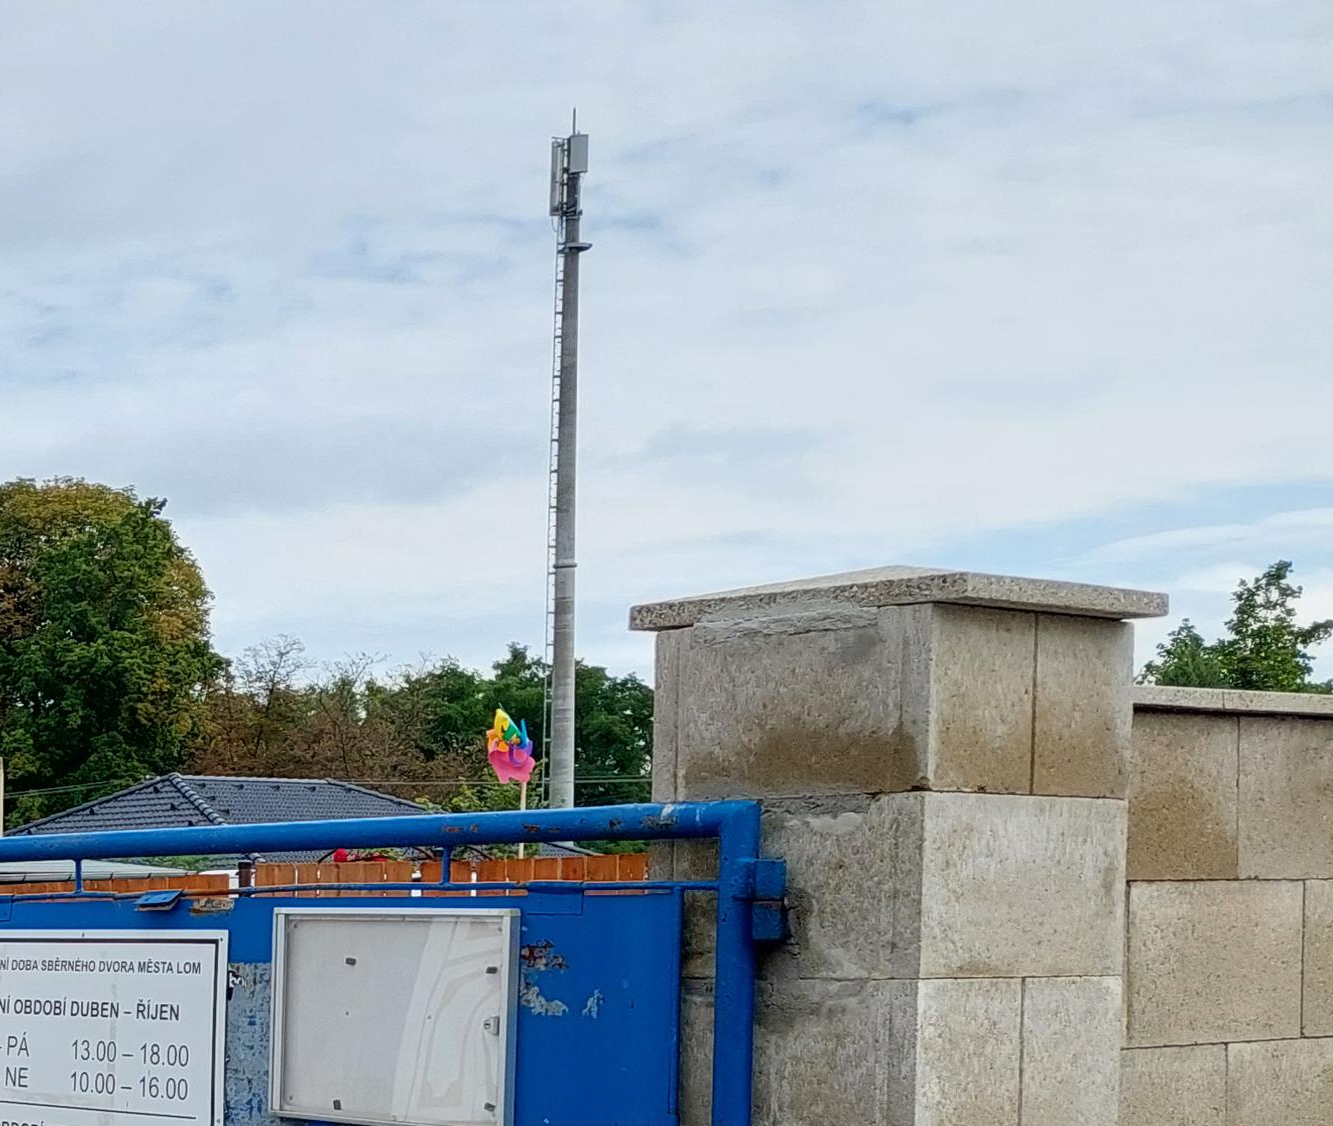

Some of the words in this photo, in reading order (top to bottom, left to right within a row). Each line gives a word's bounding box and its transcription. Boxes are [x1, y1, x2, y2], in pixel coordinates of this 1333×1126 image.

[11, 959, 39, 971] DOBA
[40, 957, 96, 972] SBĚRNÉHO
[98, 960, 135, 973] DVORA
[137, 958, 174, 974] MĚSTA
[176, 961, 202, 975] LOM
[14, 997, 67, 1016] OBDOBÍ
[70, 1001, 120, 1018] DUBEN
[136, 999, 180, 1021] ŘÍJEN
[6, 1031, 30, 1057] PÁ
[71, 1039, 117, 1062] 13.00
[140, 1042, 189, 1067] 18.00
[5, 1066, 29, 1088] NE
[70, 1071, 116, 1095] 10.00
[139, 1075, 188, 1100] 16.00
